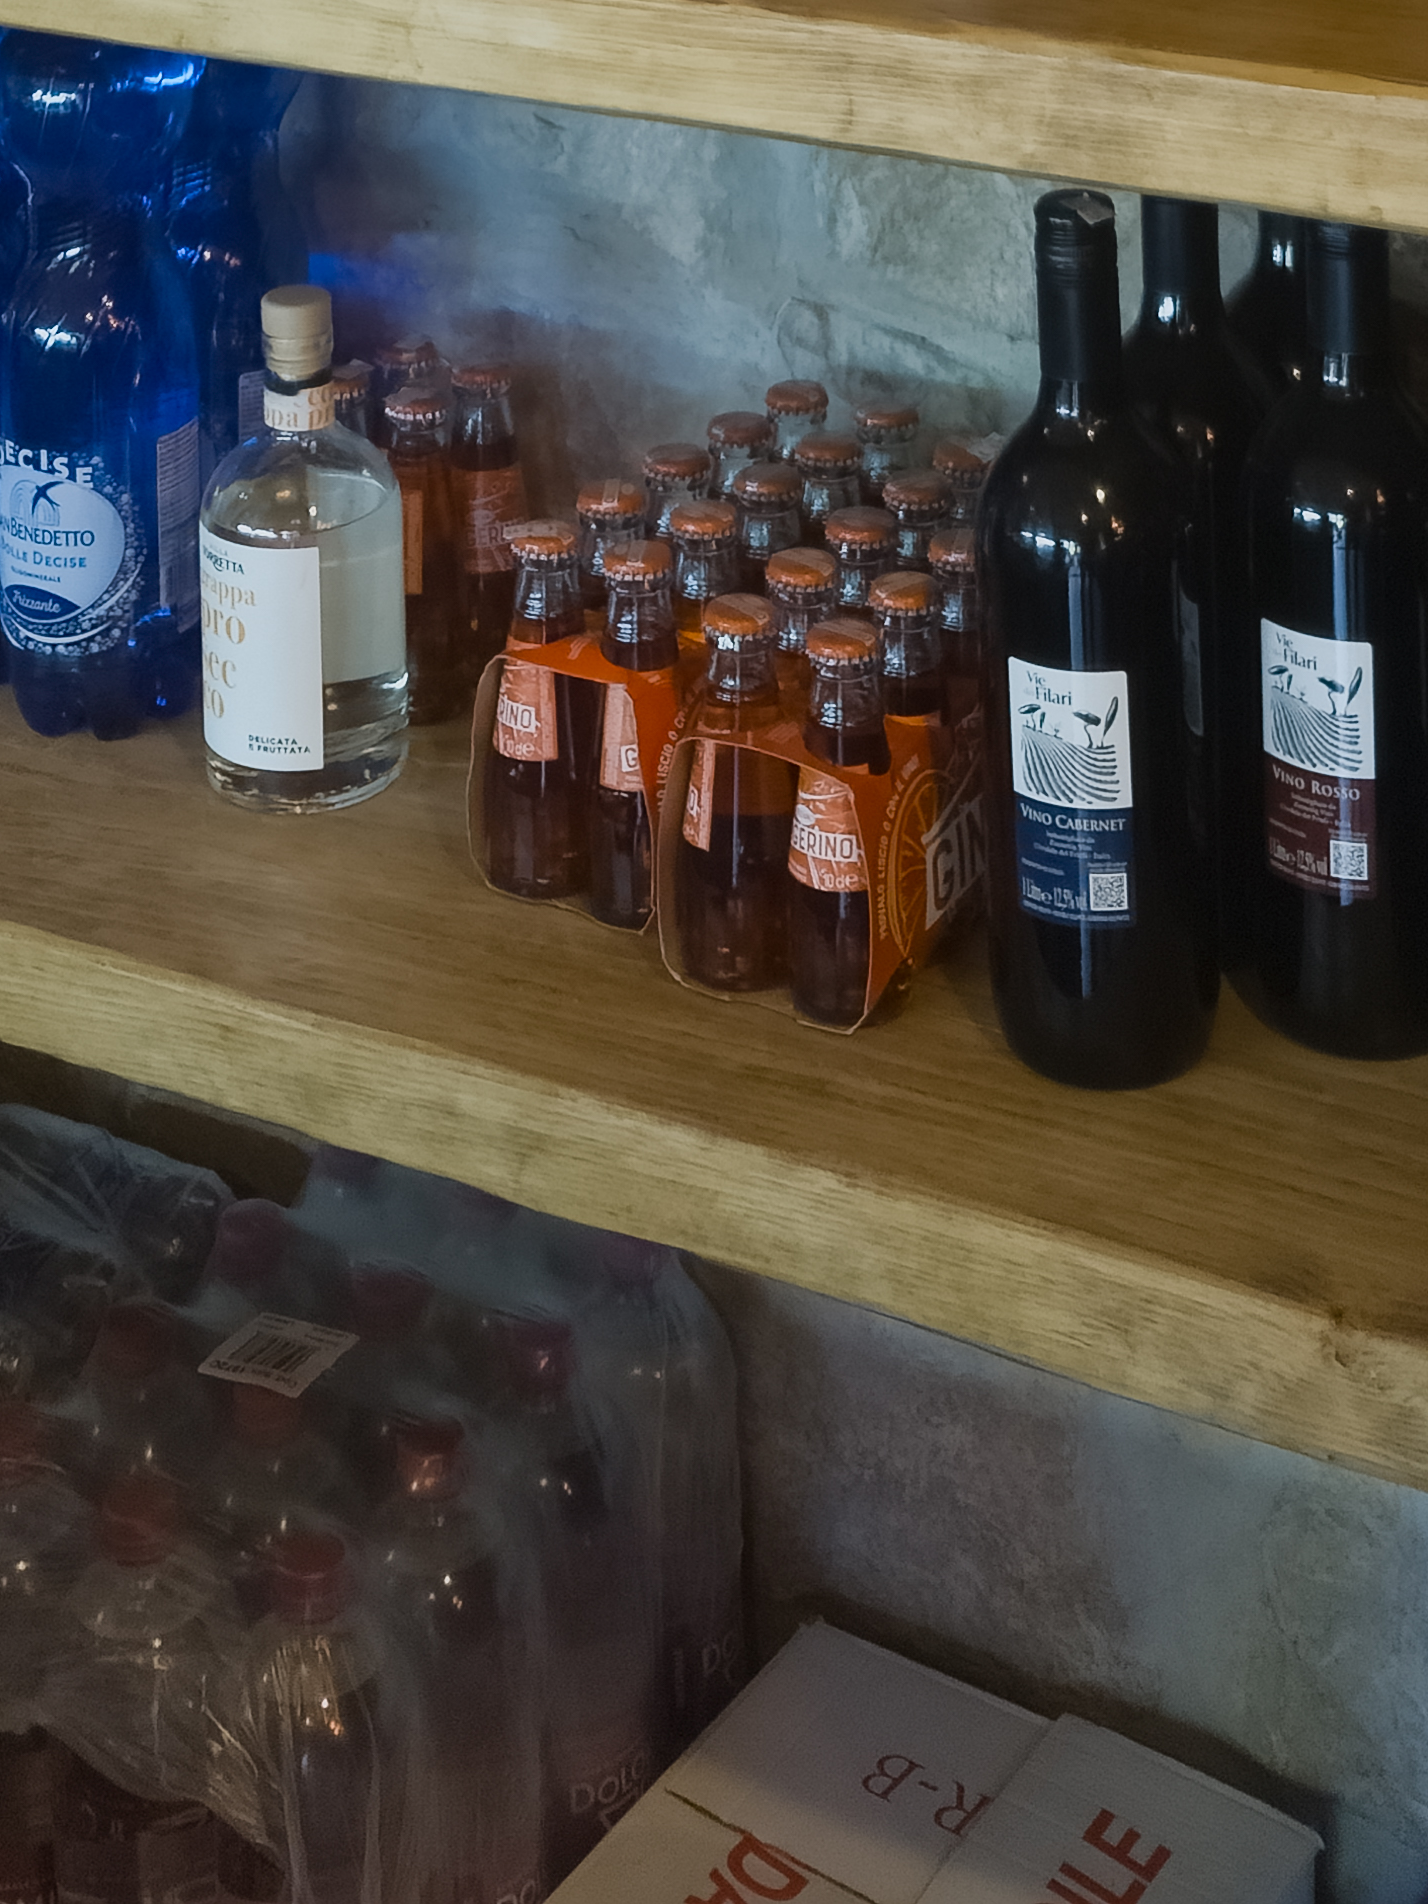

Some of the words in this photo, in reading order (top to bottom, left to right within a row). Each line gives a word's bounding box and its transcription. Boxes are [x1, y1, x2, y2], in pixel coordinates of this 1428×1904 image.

[1282, 645, 1318, 672] Filari
[1025, 670, 1047, 688] Vie
[1033, 682, 1072, 707] Filari
[246, 732, 298, 747] DELICATA
[256, 743, 311, 756] FRUTTATA
[1310, 778, 1362, 803] ROSSO
[1019, 802, 1052, 828] VINO
[1054, 812, 1126, 833] CABERNET
